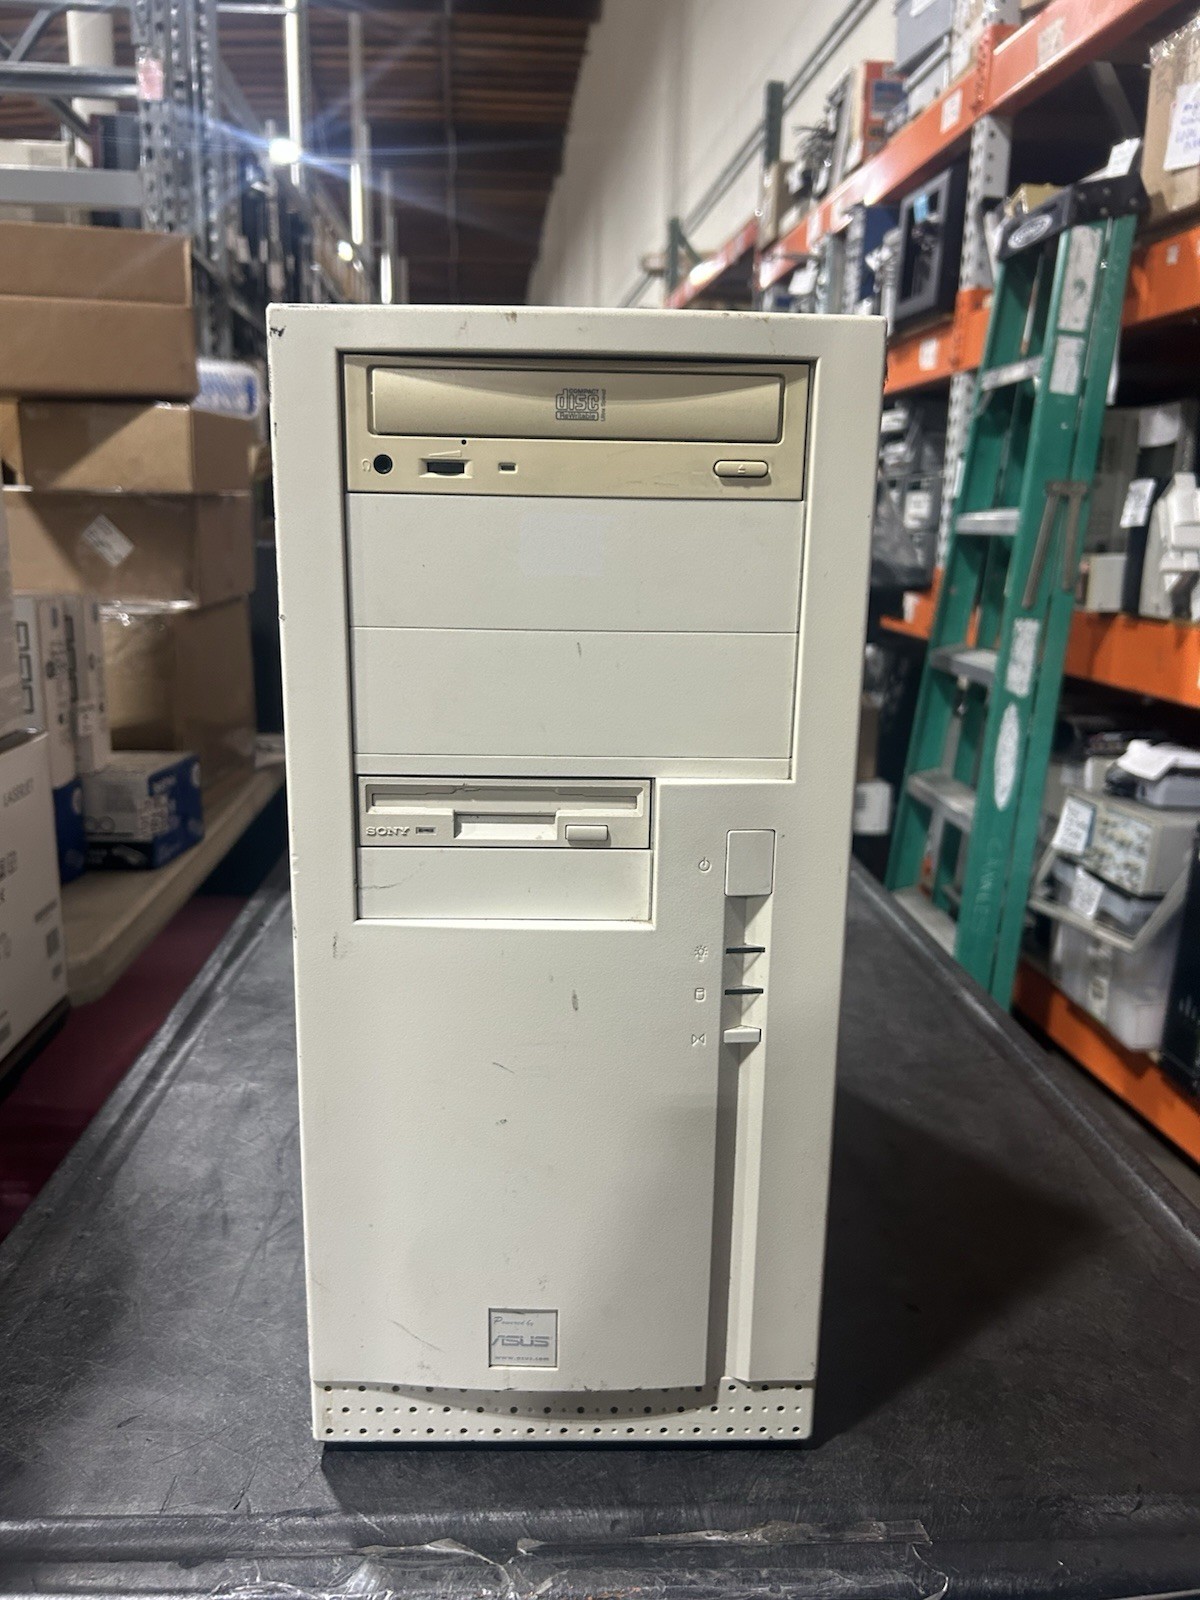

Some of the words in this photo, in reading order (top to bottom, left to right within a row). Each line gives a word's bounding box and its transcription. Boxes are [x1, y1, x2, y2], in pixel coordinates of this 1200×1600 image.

[365, 826, 410, 836] SONY
[493, 1316, 525, 1325] Powered
[491, 1334, 550, 1347] ASUS
